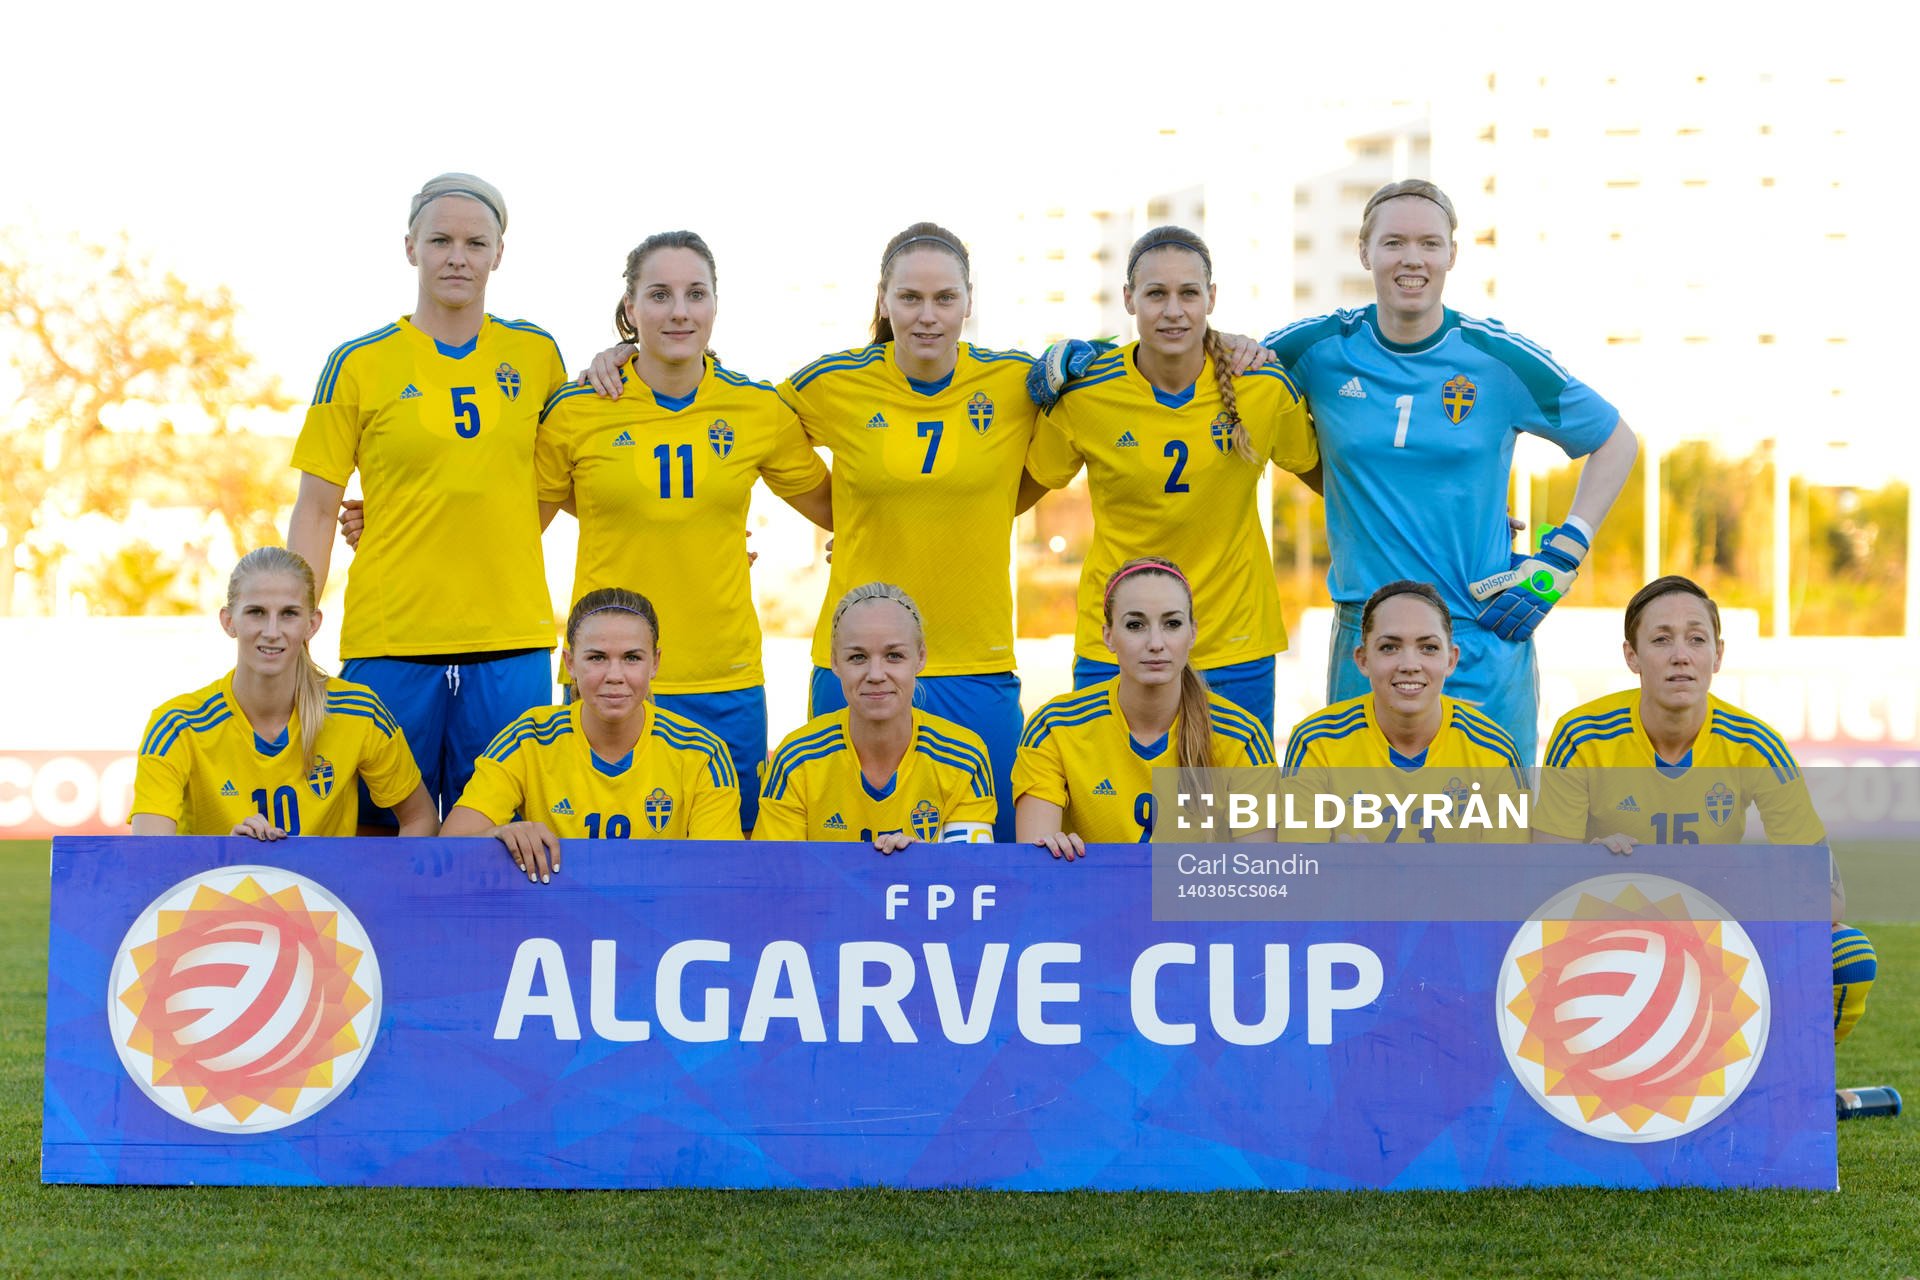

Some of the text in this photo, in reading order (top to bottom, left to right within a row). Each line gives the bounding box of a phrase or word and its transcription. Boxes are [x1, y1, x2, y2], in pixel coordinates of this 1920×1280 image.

[450, 386, 482, 439] 5
[1337, 388, 1368, 399] adidas
[1393, 395, 1415, 448] 1
[653, 445, 695, 500] 11
[917, 422, 945, 475] 7
[1164, 440, 1190, 494] 2
[251, 785, 302, 837] 10
[1135, 793, 1160, 843] 9
[493, 937, 1385, 1046] ALGARVE CUP
